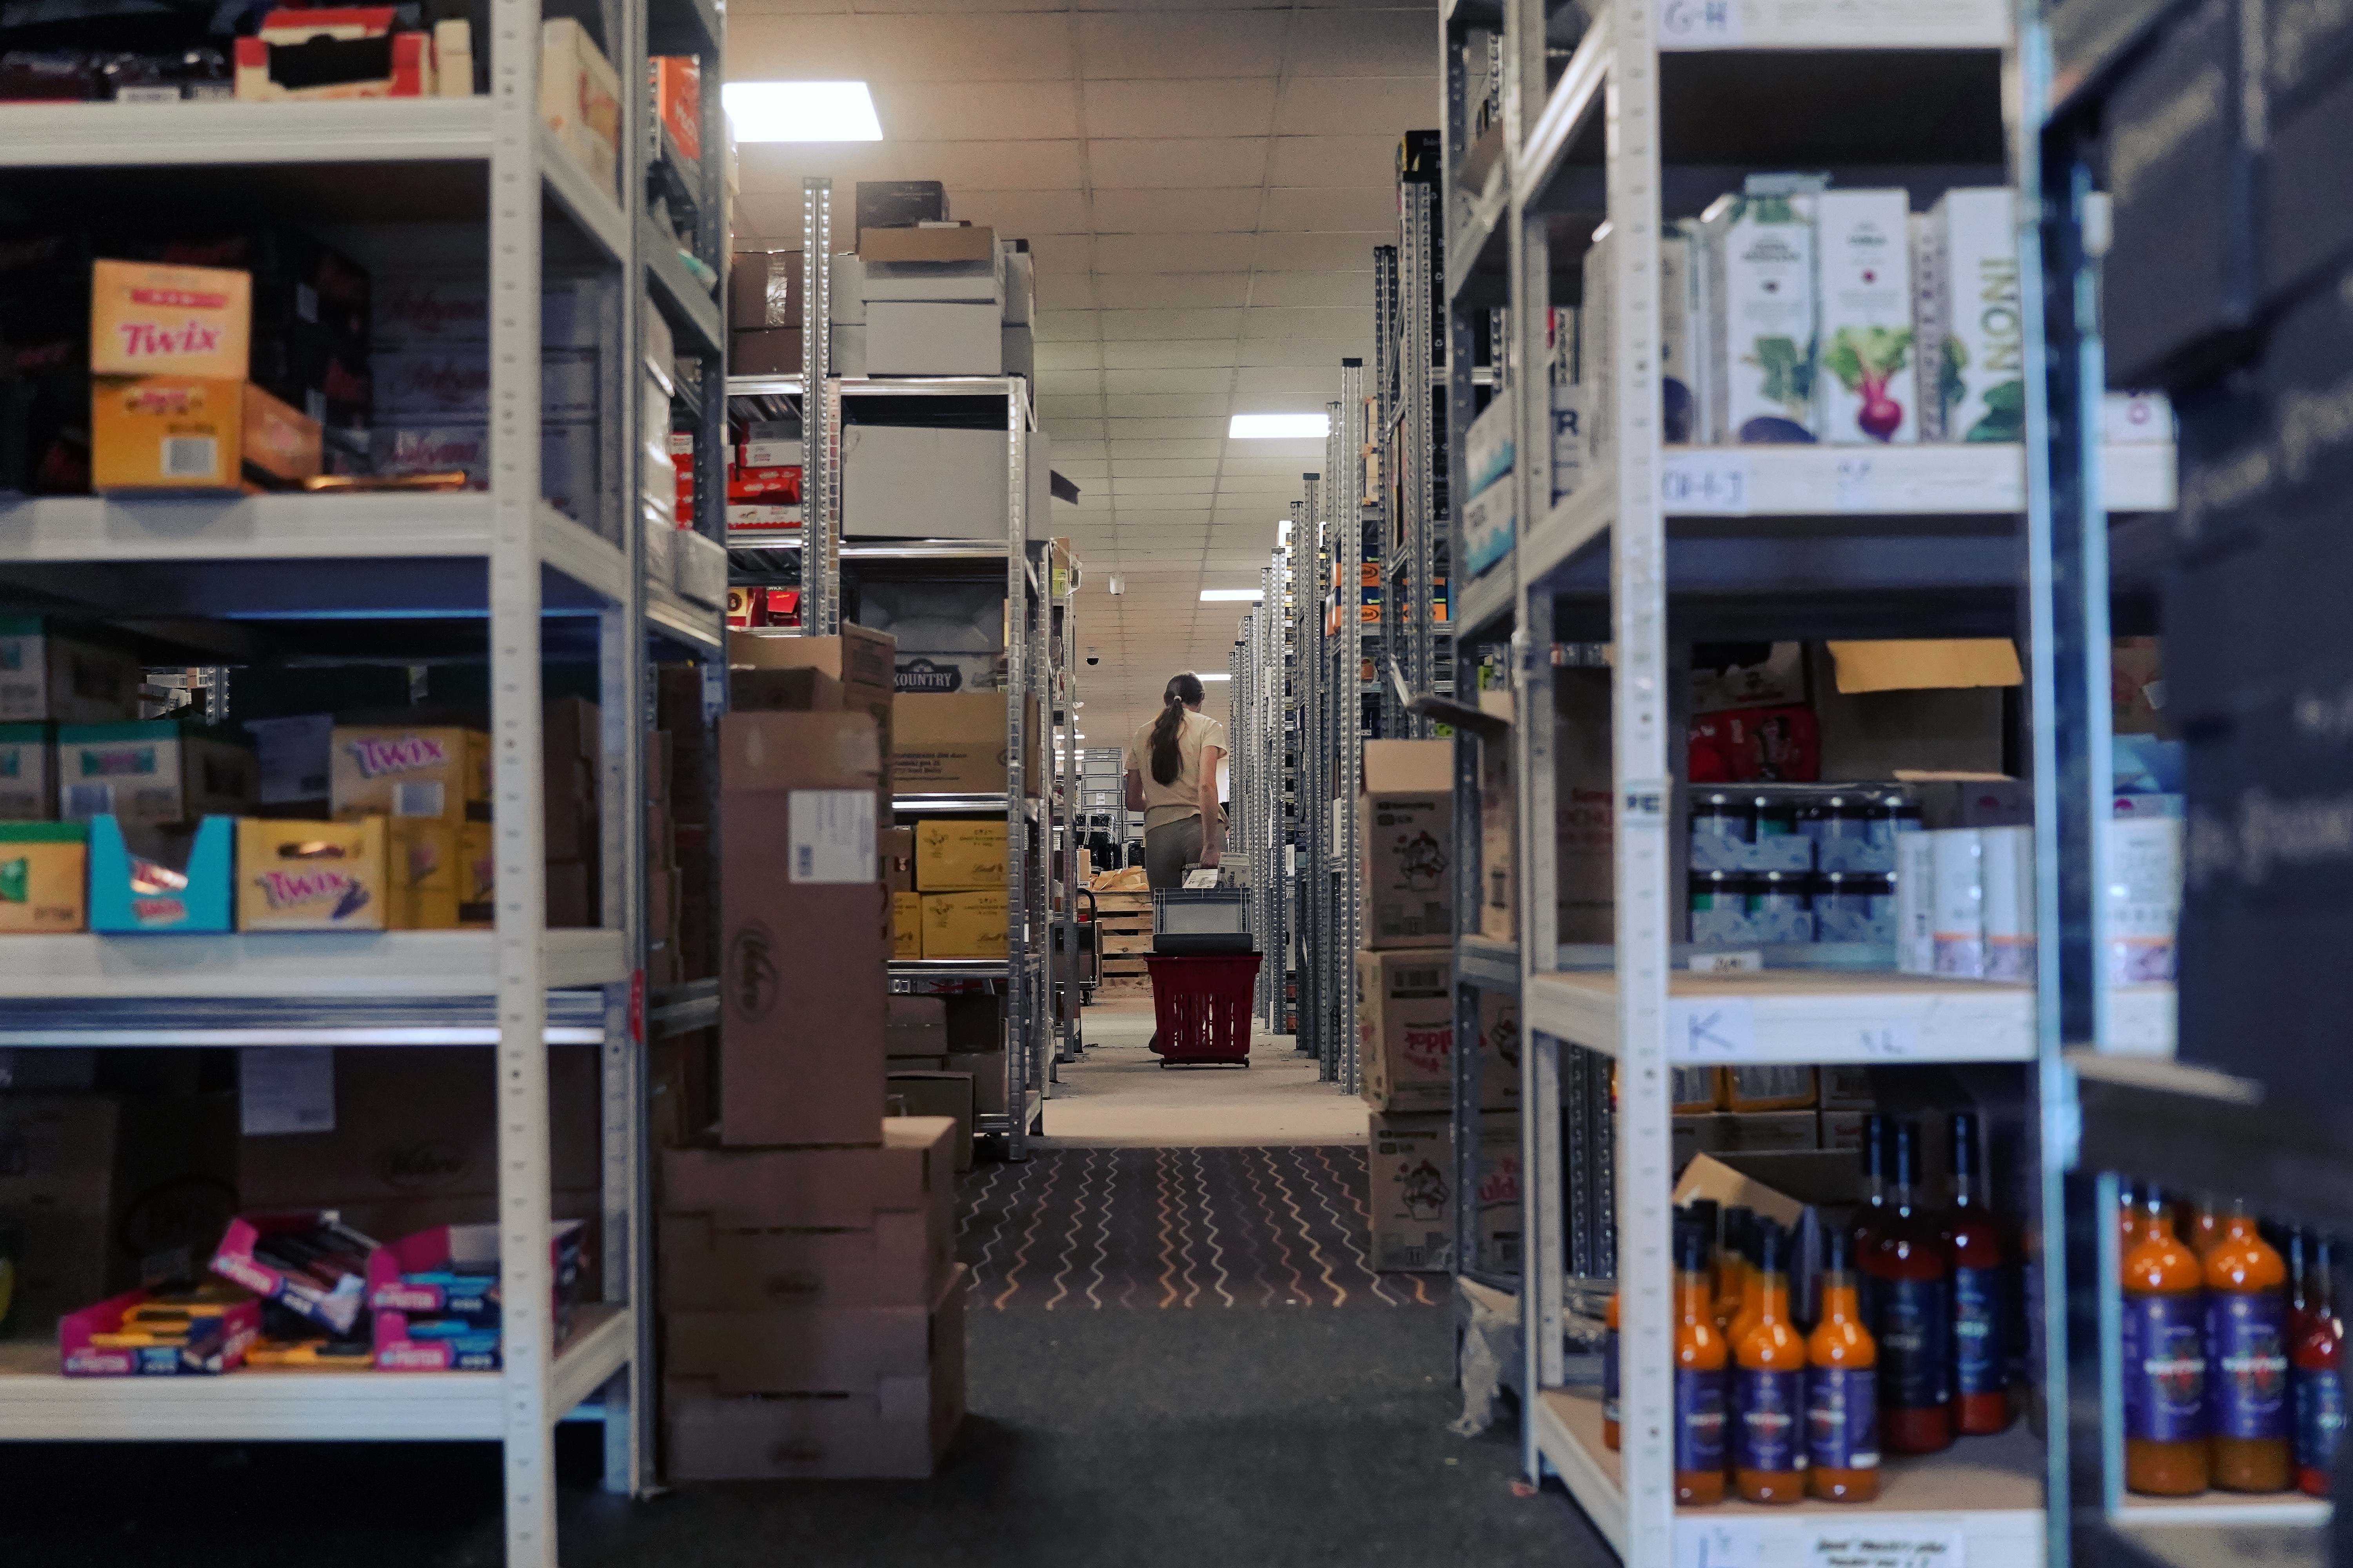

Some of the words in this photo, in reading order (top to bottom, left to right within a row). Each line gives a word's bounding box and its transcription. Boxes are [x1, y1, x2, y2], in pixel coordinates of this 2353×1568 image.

[121, 319, 220, 356] Twix
[350, 735, 445, 773] Twix
[259, 868, 351, 906] Twix
